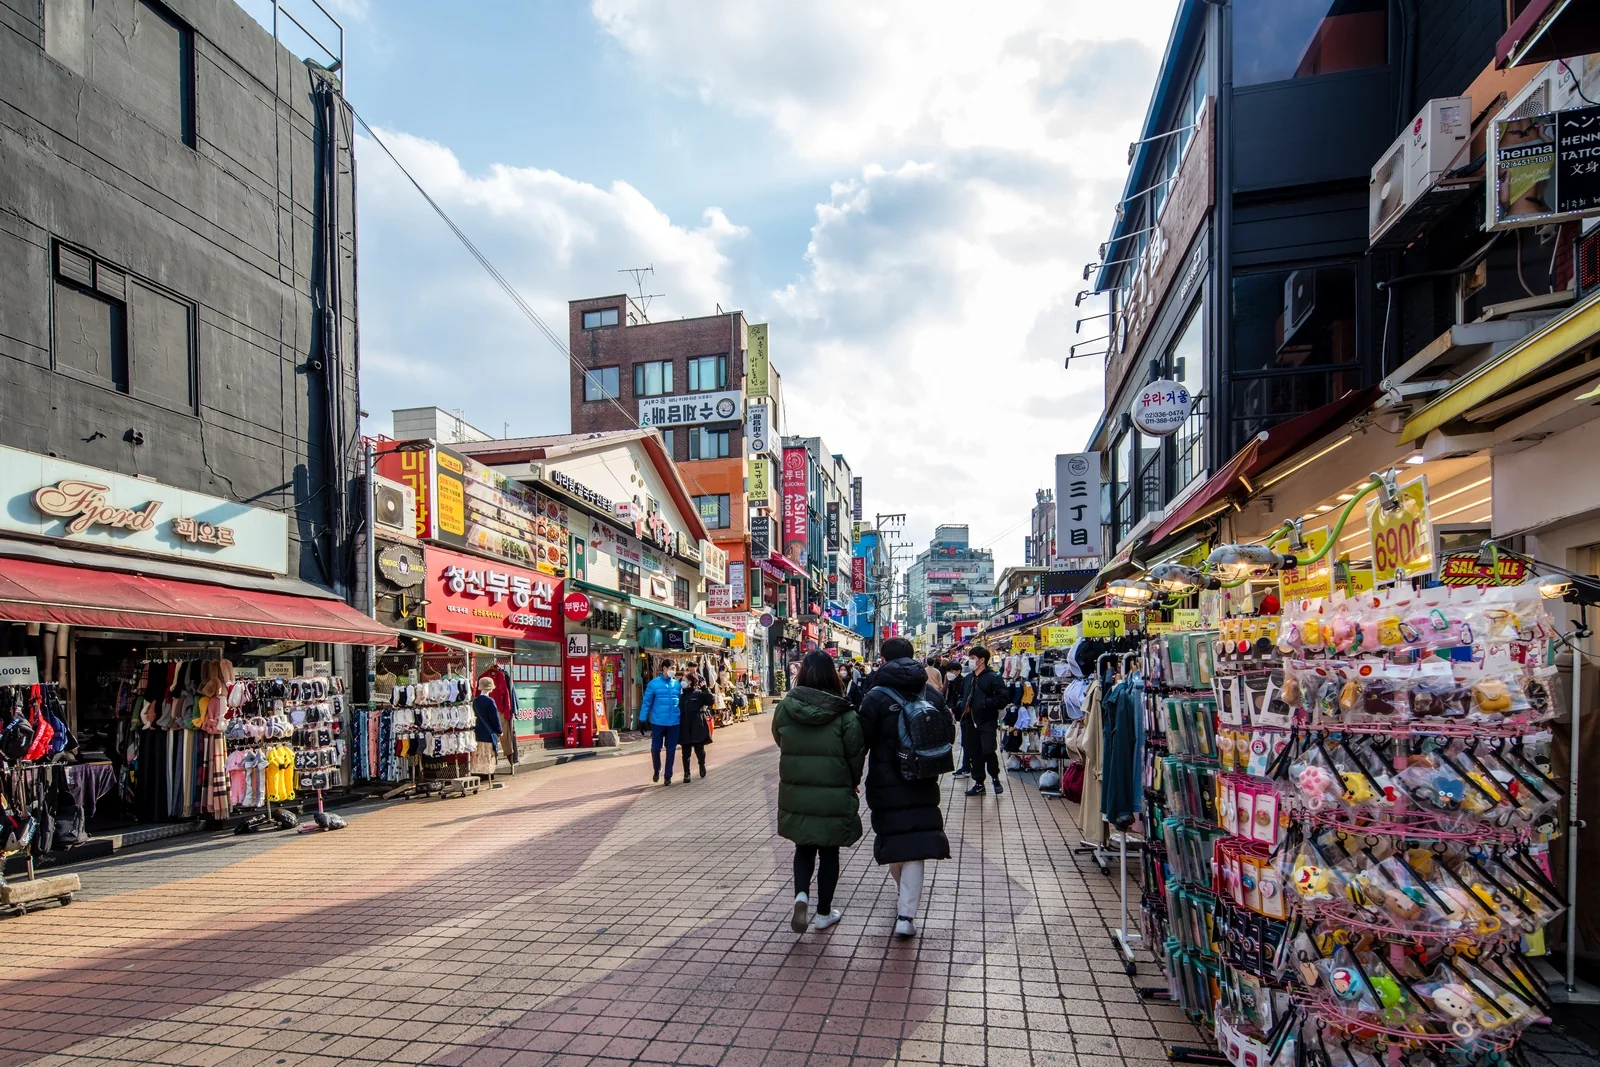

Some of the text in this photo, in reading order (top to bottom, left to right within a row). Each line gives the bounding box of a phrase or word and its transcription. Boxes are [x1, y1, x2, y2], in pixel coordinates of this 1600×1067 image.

[1558, 71, 1571, 89] LG
[1414, 133, 1422, 147] LG
[1500, 144, 1554, 160] henna
[1570, 160, 1599, 176] 文身
[652, 401, 714, 425] 수제담배
[1145, 409, 1184, 419] 02)336-0474
[1145, 416, 1185, 425] 011-388-0474
[785, 470, 804, 481] 루타
[700, 503, 718, 515] 임대
[784, 493, 794, 517] food
[30, 480, 236, 548] Fjord 피오르
[794, 493, 806, 534] ASIAN
[1069, 480, 1088, 546] 三丁目
[1375, 517, 1426, 573] 6900
[409, 563, 425, 573] SANTA
[854, 558, 863, 589] 보드게임
[446, 565, 553, 611] 성신부동산
[709, 588, 730, 596] 마라탕
[564, 601, 588, 612] 부동산
[416, 616, 427, 628] B1
[518, 613, 553, 628] 338-8112
[568, 646, 587, 654] PIEU
[570, 665, 588, 729] 부동산
[518, 707, 553, 721] 338-8112
